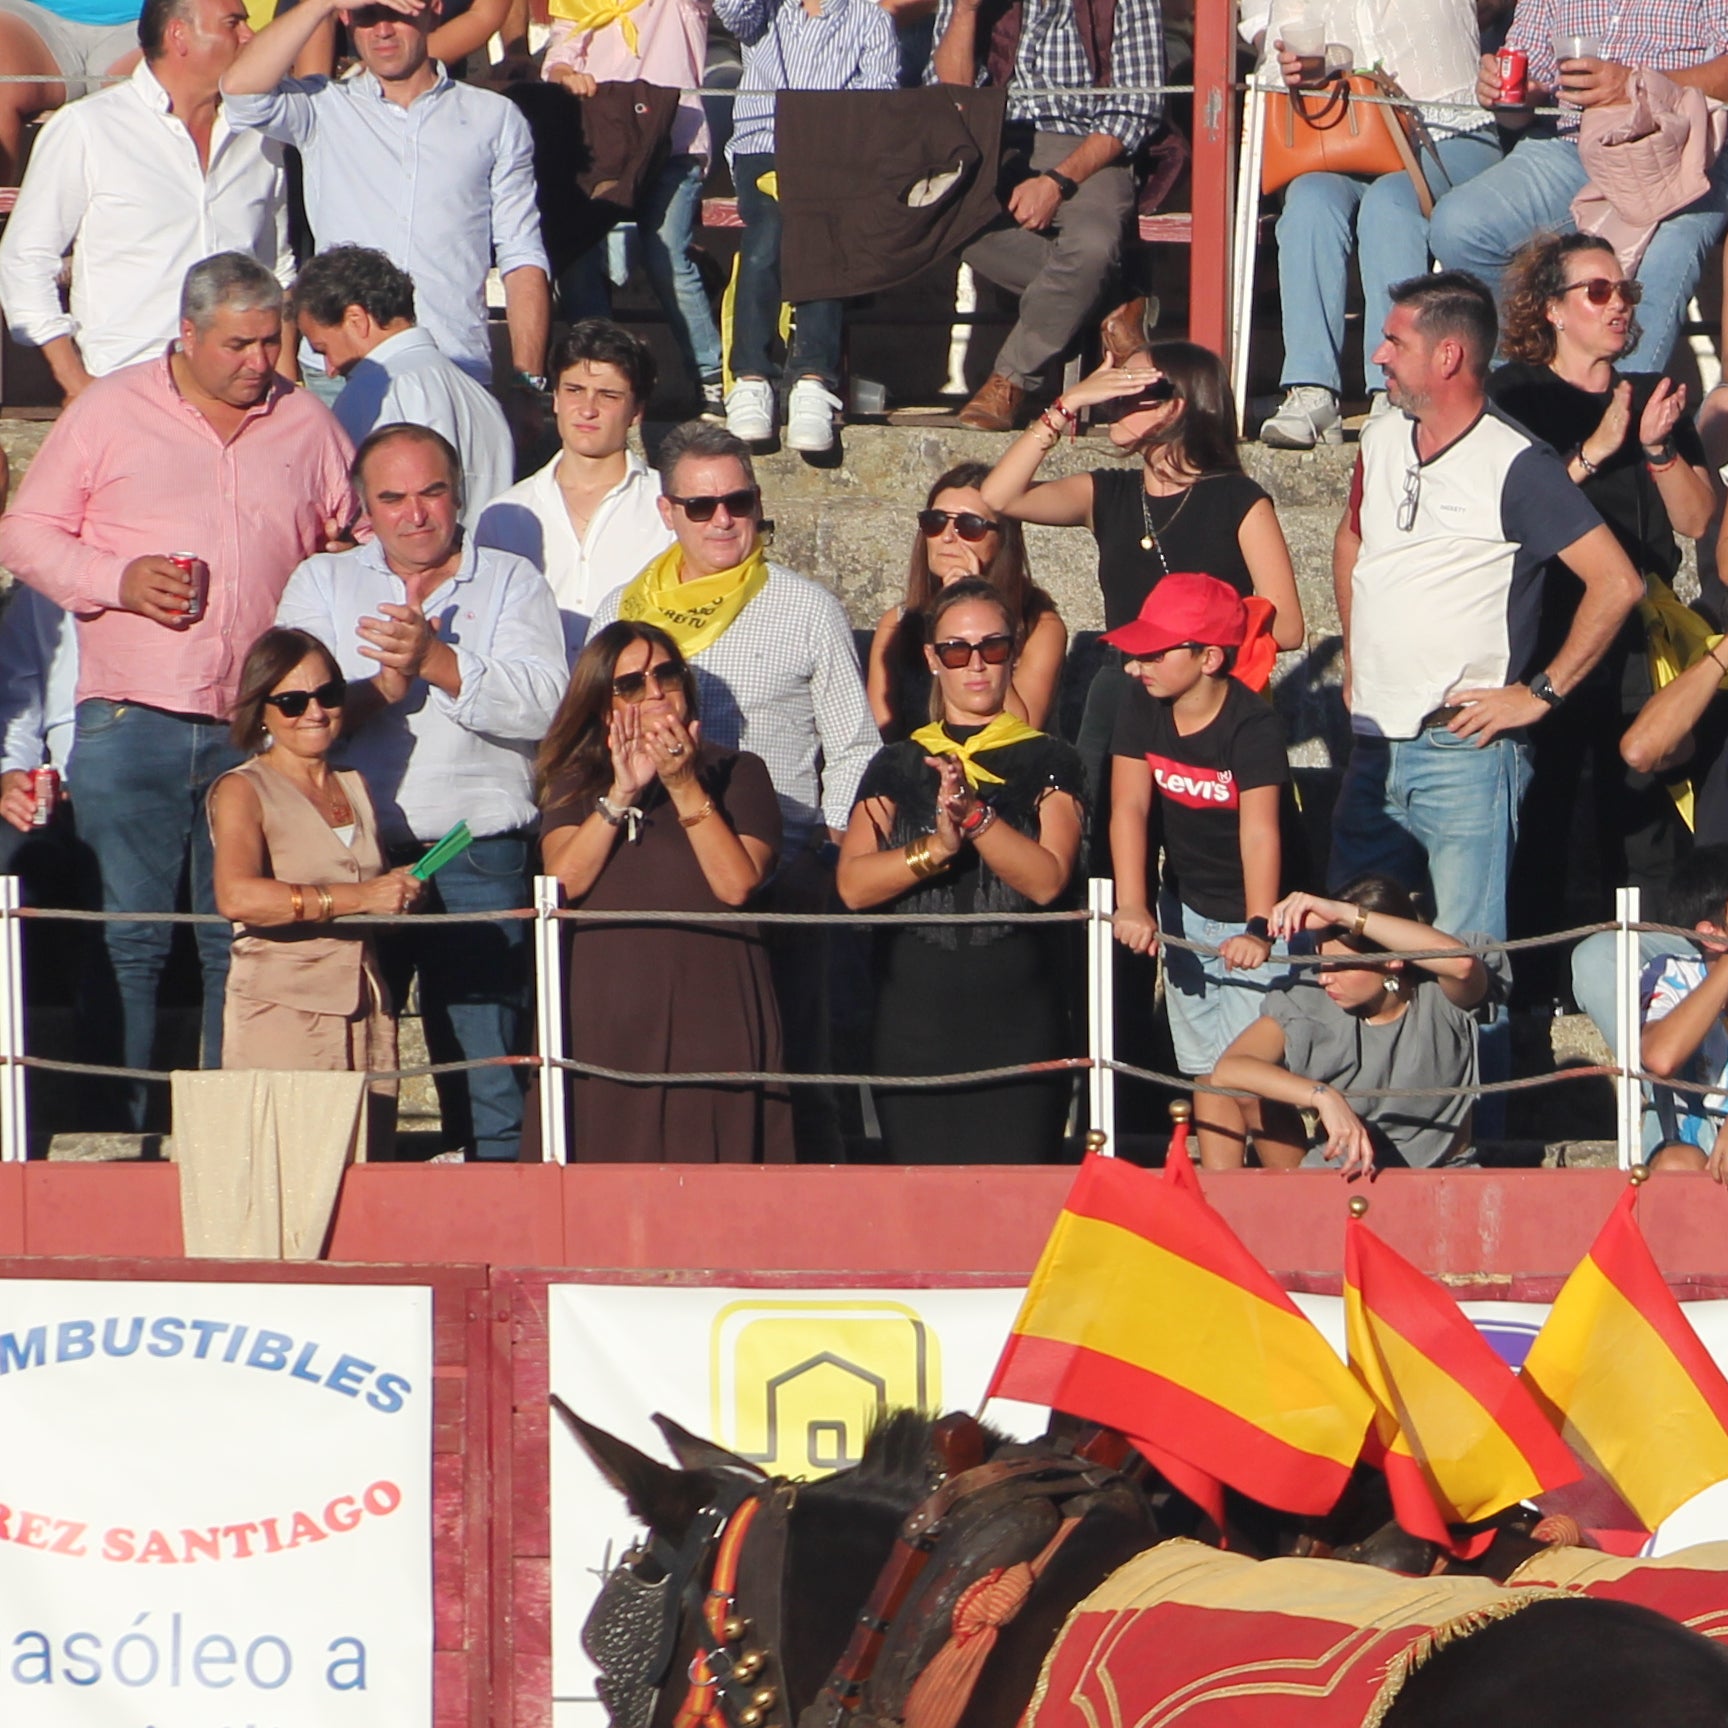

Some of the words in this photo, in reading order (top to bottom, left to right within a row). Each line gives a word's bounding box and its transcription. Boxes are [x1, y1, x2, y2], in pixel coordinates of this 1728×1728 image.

[101, 1479, 402, 1565] SANTIAGO
[11, 1612, 293, 1692] asóleo
[326, 1635, 369, 1692] a
